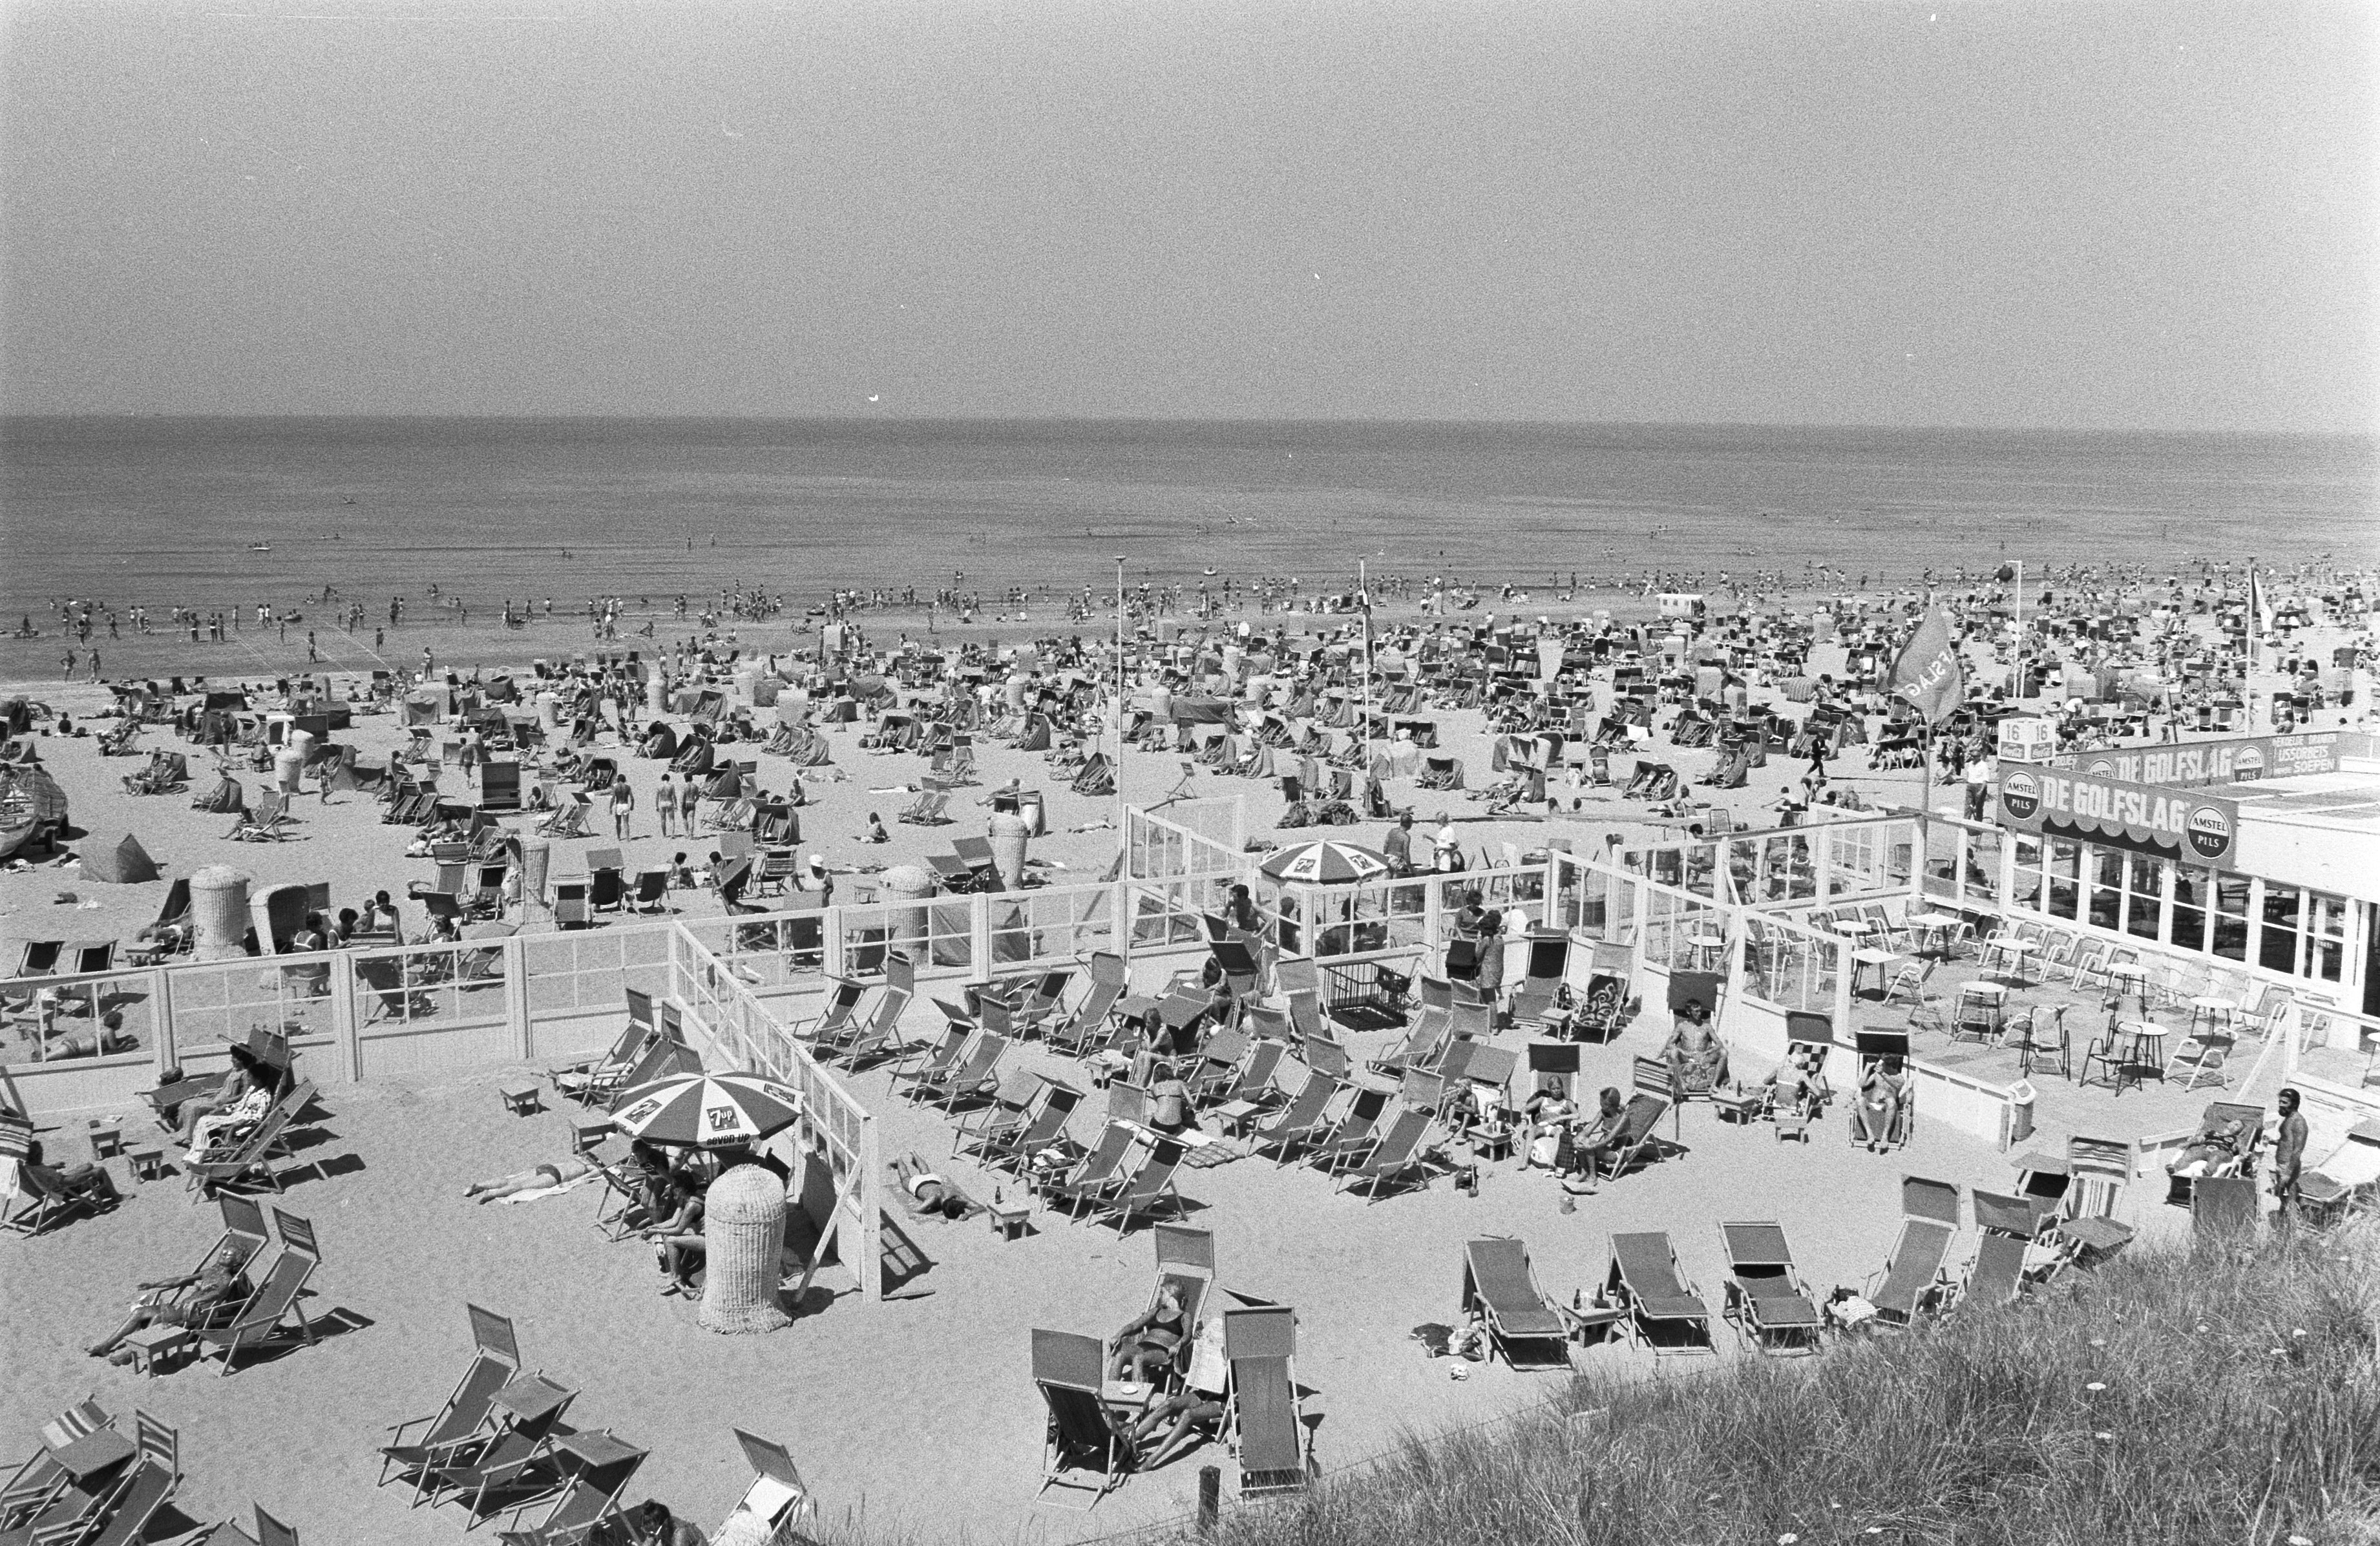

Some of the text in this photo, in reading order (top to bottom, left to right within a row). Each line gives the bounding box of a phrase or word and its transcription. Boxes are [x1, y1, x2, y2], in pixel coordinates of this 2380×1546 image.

[2006, 723, 2020, 741] 16
[2036, 724, 2048, 742] 16
[2240, 771, 2257, 780] PILS
[2007, 782, 2036, 794] AMSTEL
[2012, 799, 2030, 810] PILS
[2193, 817, 2227, 831] AMSTEL
[2198, 835, 2219, 848] PILS
